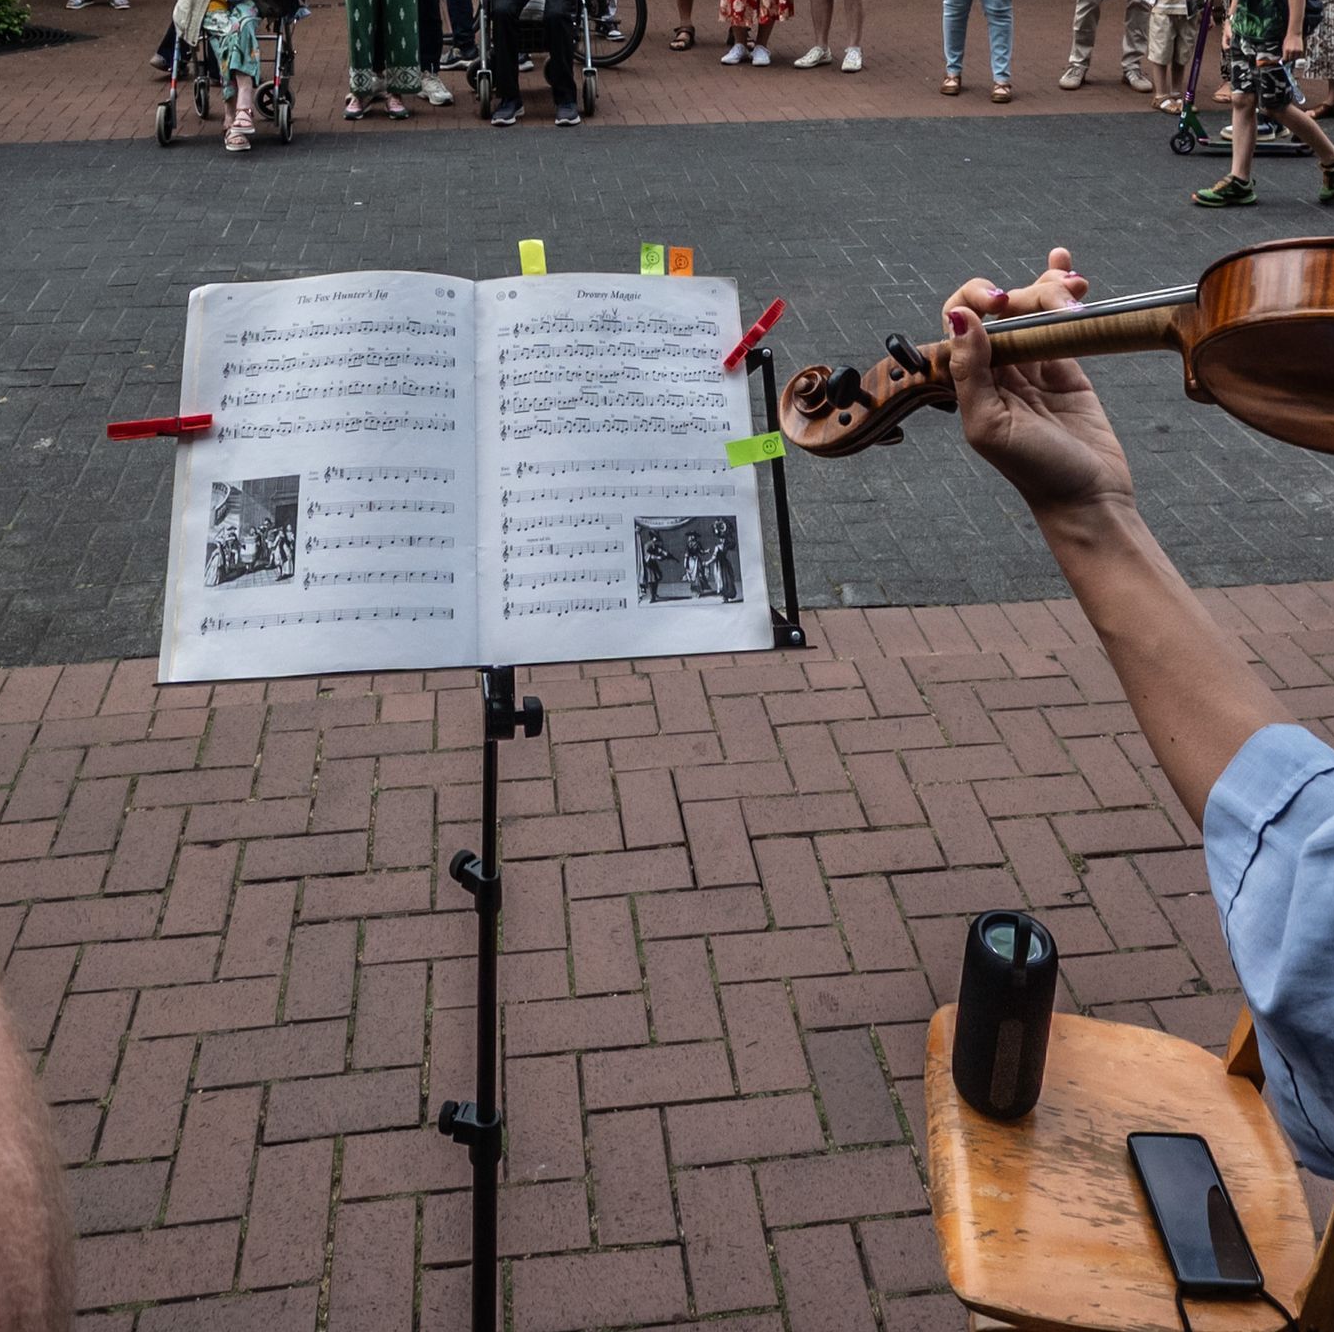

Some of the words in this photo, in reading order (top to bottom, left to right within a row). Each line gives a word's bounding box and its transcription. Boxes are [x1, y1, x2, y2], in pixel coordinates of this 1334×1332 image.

[297, 295, 312, 305] The
[314, 292, 329, 302] Fox
[332, 289, 373, 301] Hunter's
[374, 288, 389, 301] Jig
[577, 289, 609, 301] Drowsy
[610, 290, 642, 302] Maggie
